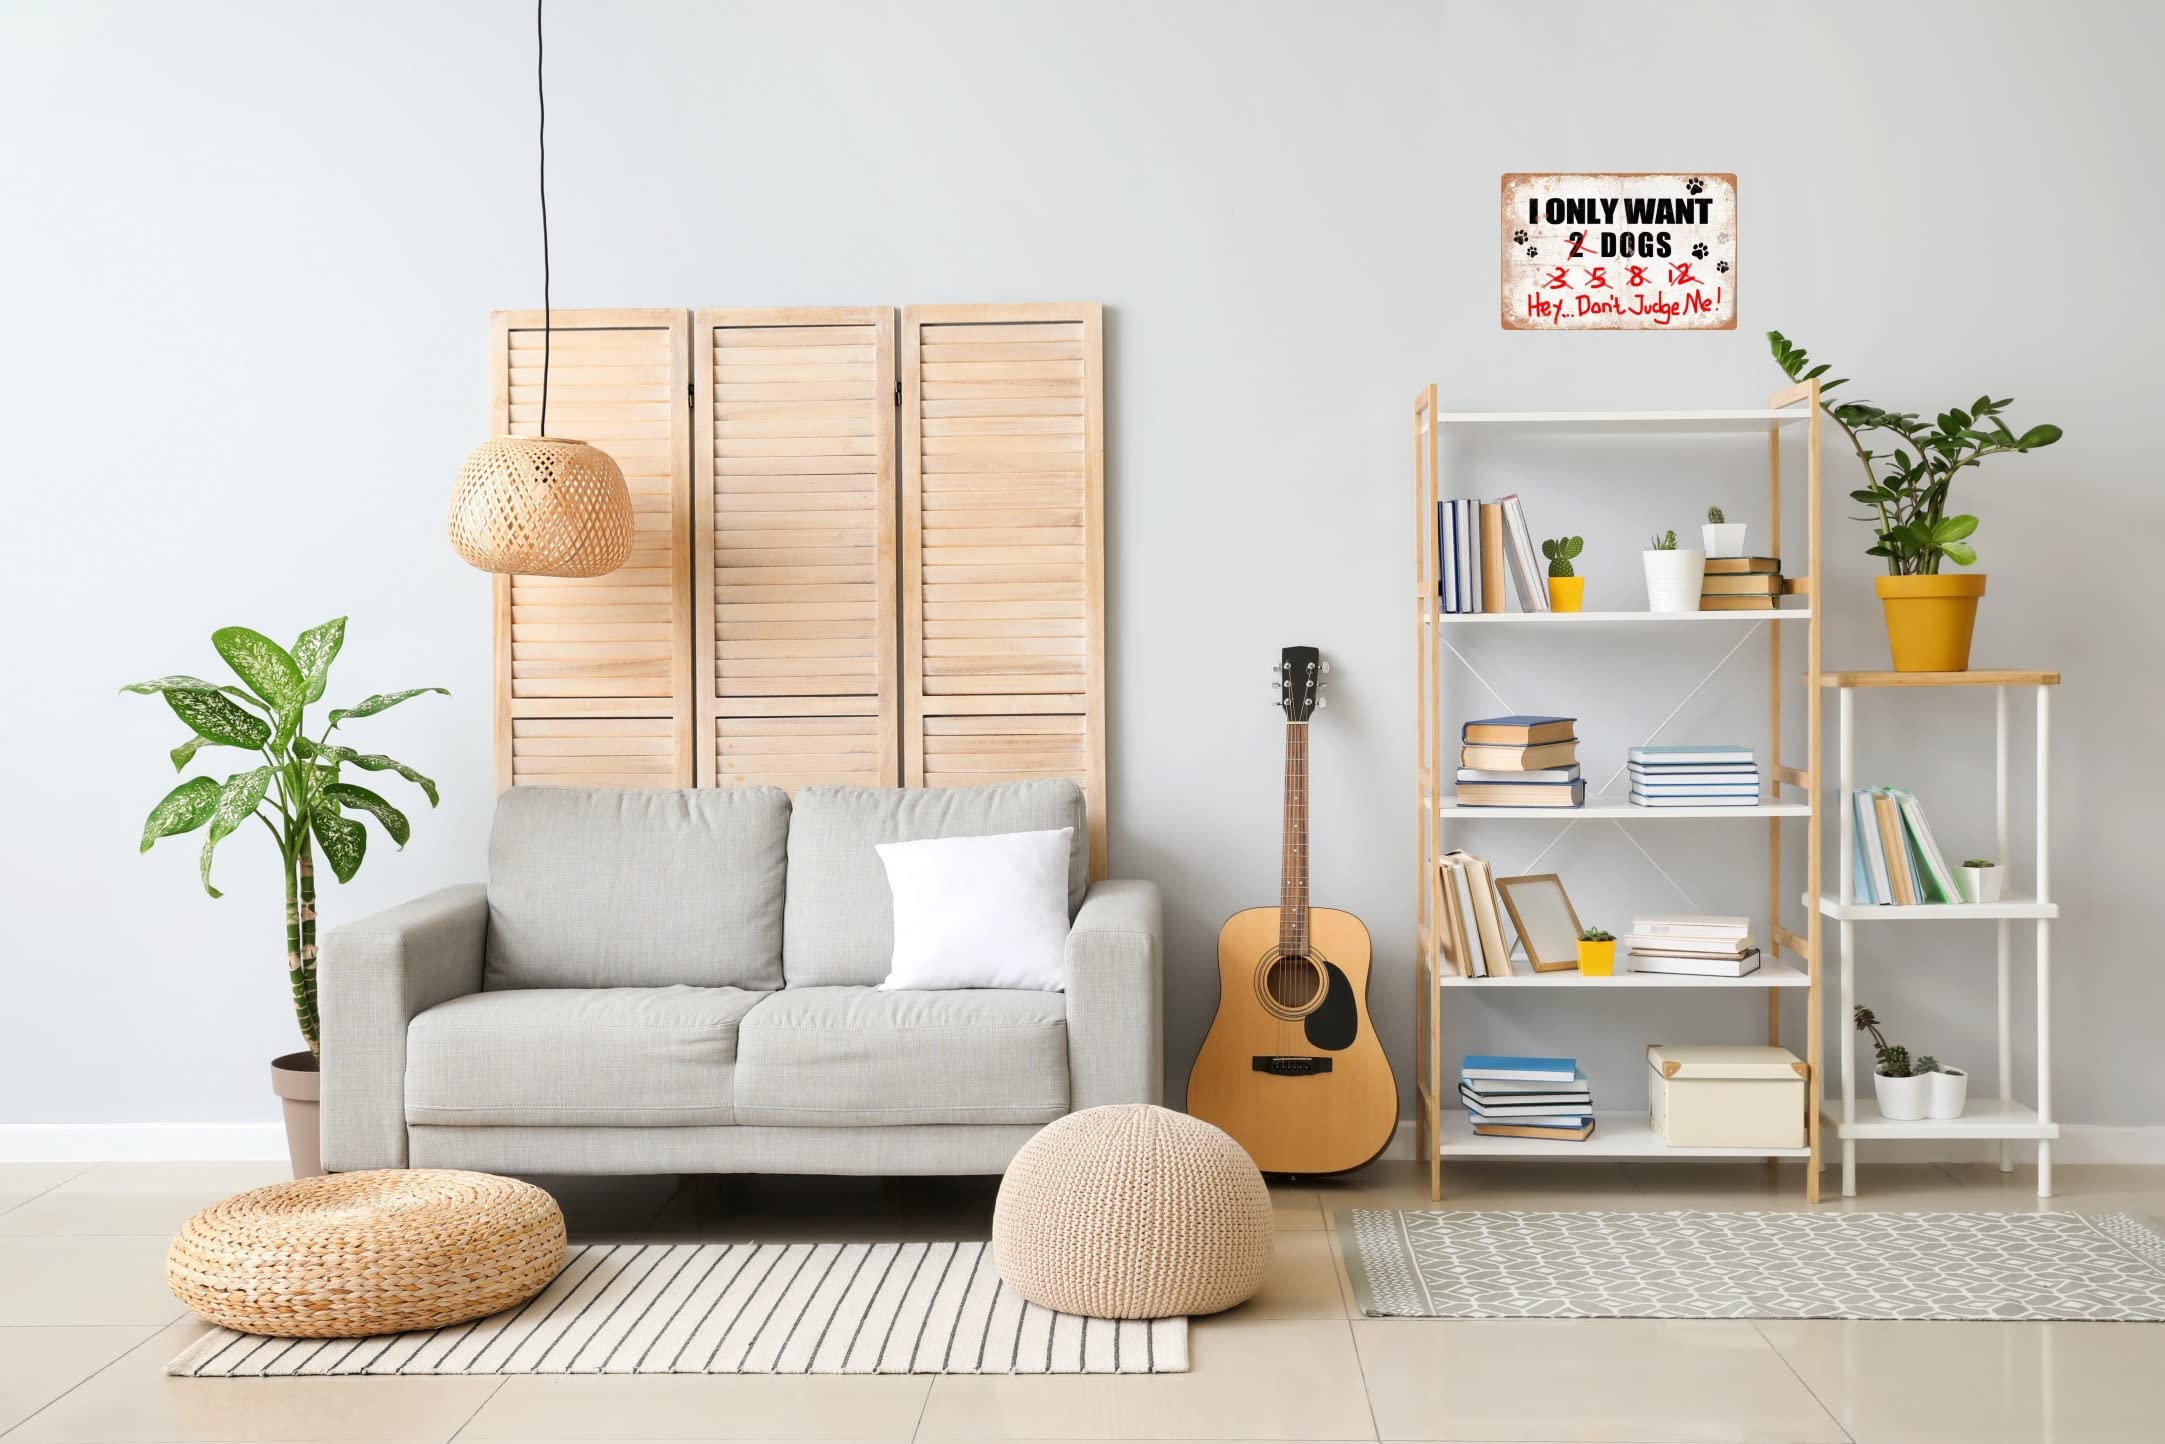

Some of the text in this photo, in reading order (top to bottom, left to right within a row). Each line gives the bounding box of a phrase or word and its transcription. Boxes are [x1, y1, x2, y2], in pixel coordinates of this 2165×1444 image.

[1529, 197, 1713, 225] I ONLY WANT
[1601, 231, 1672, 258] DOGS
[1528, 292, 1574, 324] Hey...
[1575, 293, 1626, 315] Don't
[1628, 291, 1680, 324] Judge
